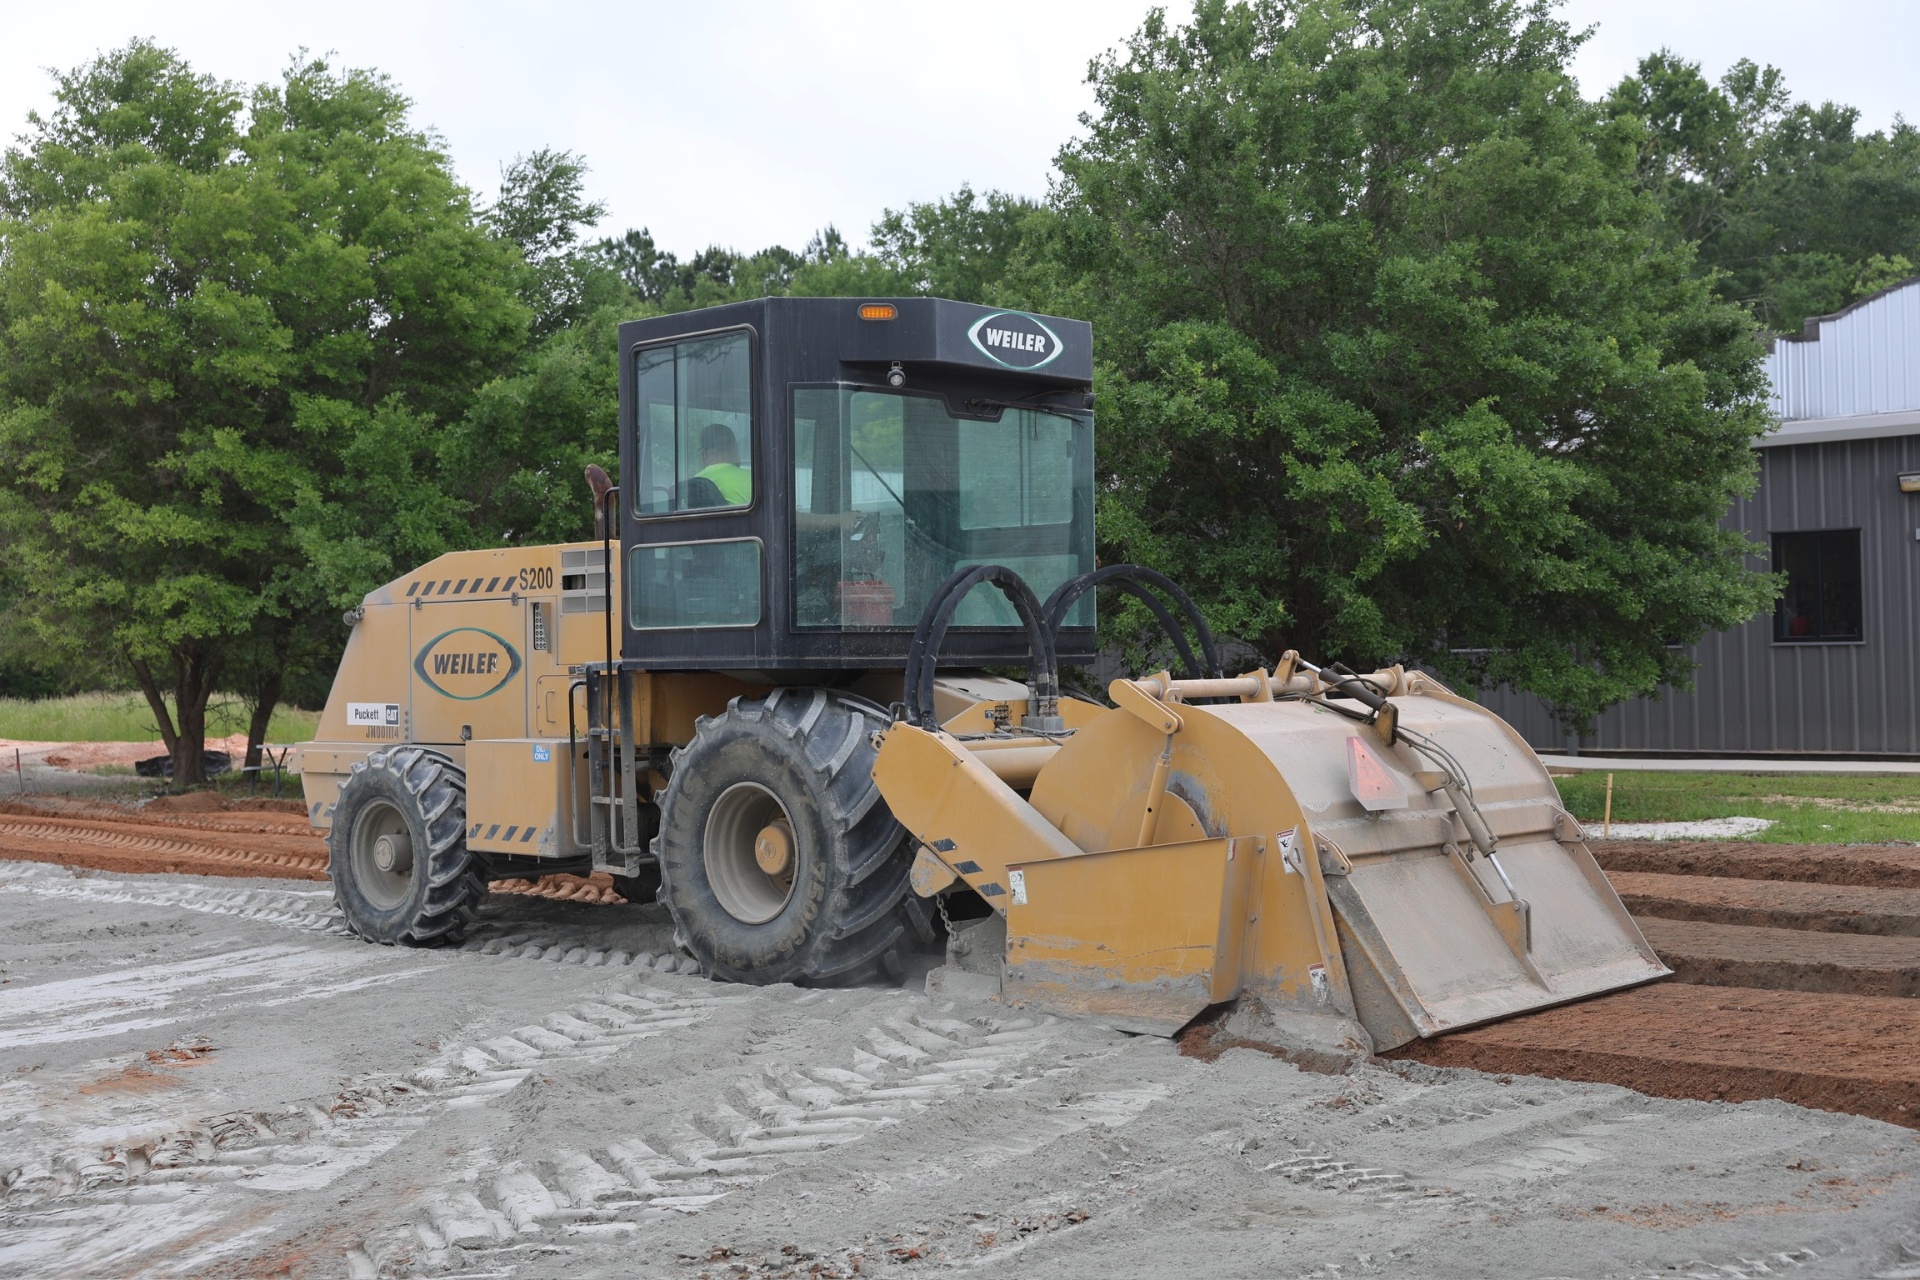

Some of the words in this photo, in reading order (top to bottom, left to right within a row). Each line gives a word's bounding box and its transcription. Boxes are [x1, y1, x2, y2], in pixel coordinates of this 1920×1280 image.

[986, 328, 1045, 353] WEILER
[519, 567, 553, 590] S200
[434, 653, 498, 674] WEILER
[354, 708, 379, 720] Puckett
[386, 709, 398, 721] CAT
